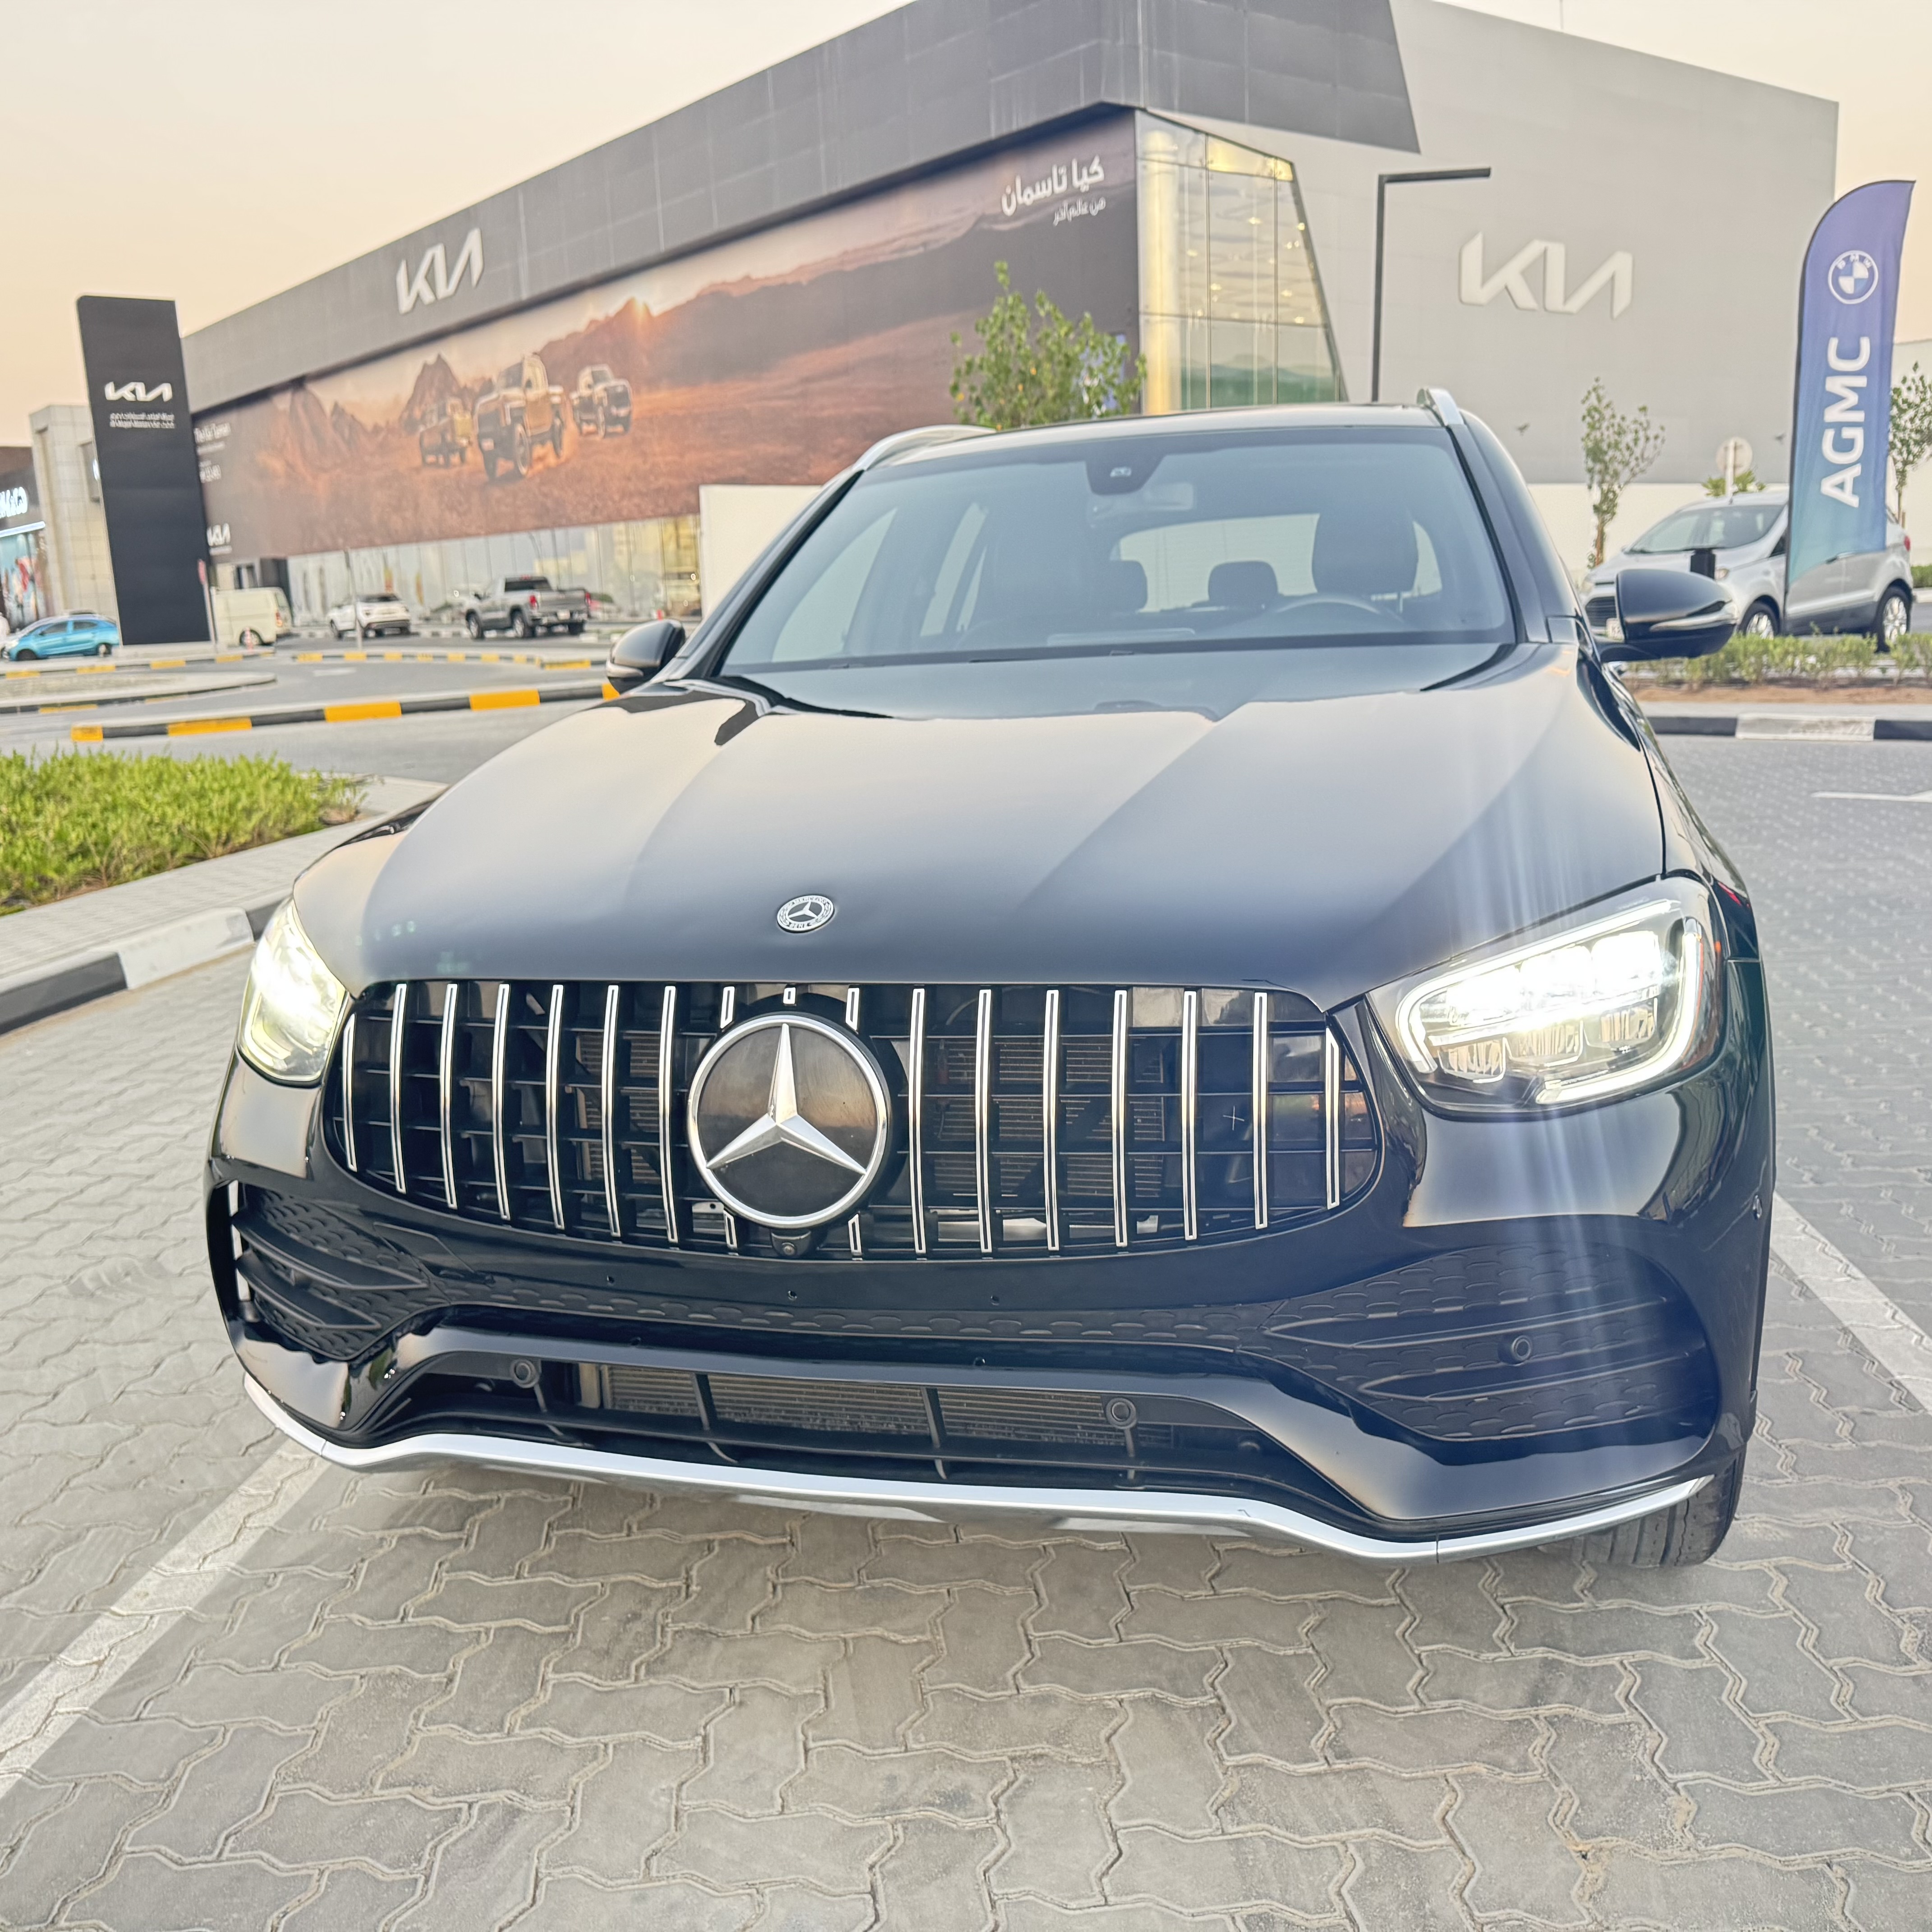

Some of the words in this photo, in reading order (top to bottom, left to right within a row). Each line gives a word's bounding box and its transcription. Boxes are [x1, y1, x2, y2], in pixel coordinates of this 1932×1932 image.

[1001, 164, 1067, 216] تاسمان
[1071, 154, 1104, 193] كيا
[1089, 197, 1106, 216] من
[396, 227, 483, 315] KIA
[1459, 231, 1633, 320] KIA
[105, 382, 173, 402] KIA
[1821, 336, 1870, 508] AGMC
